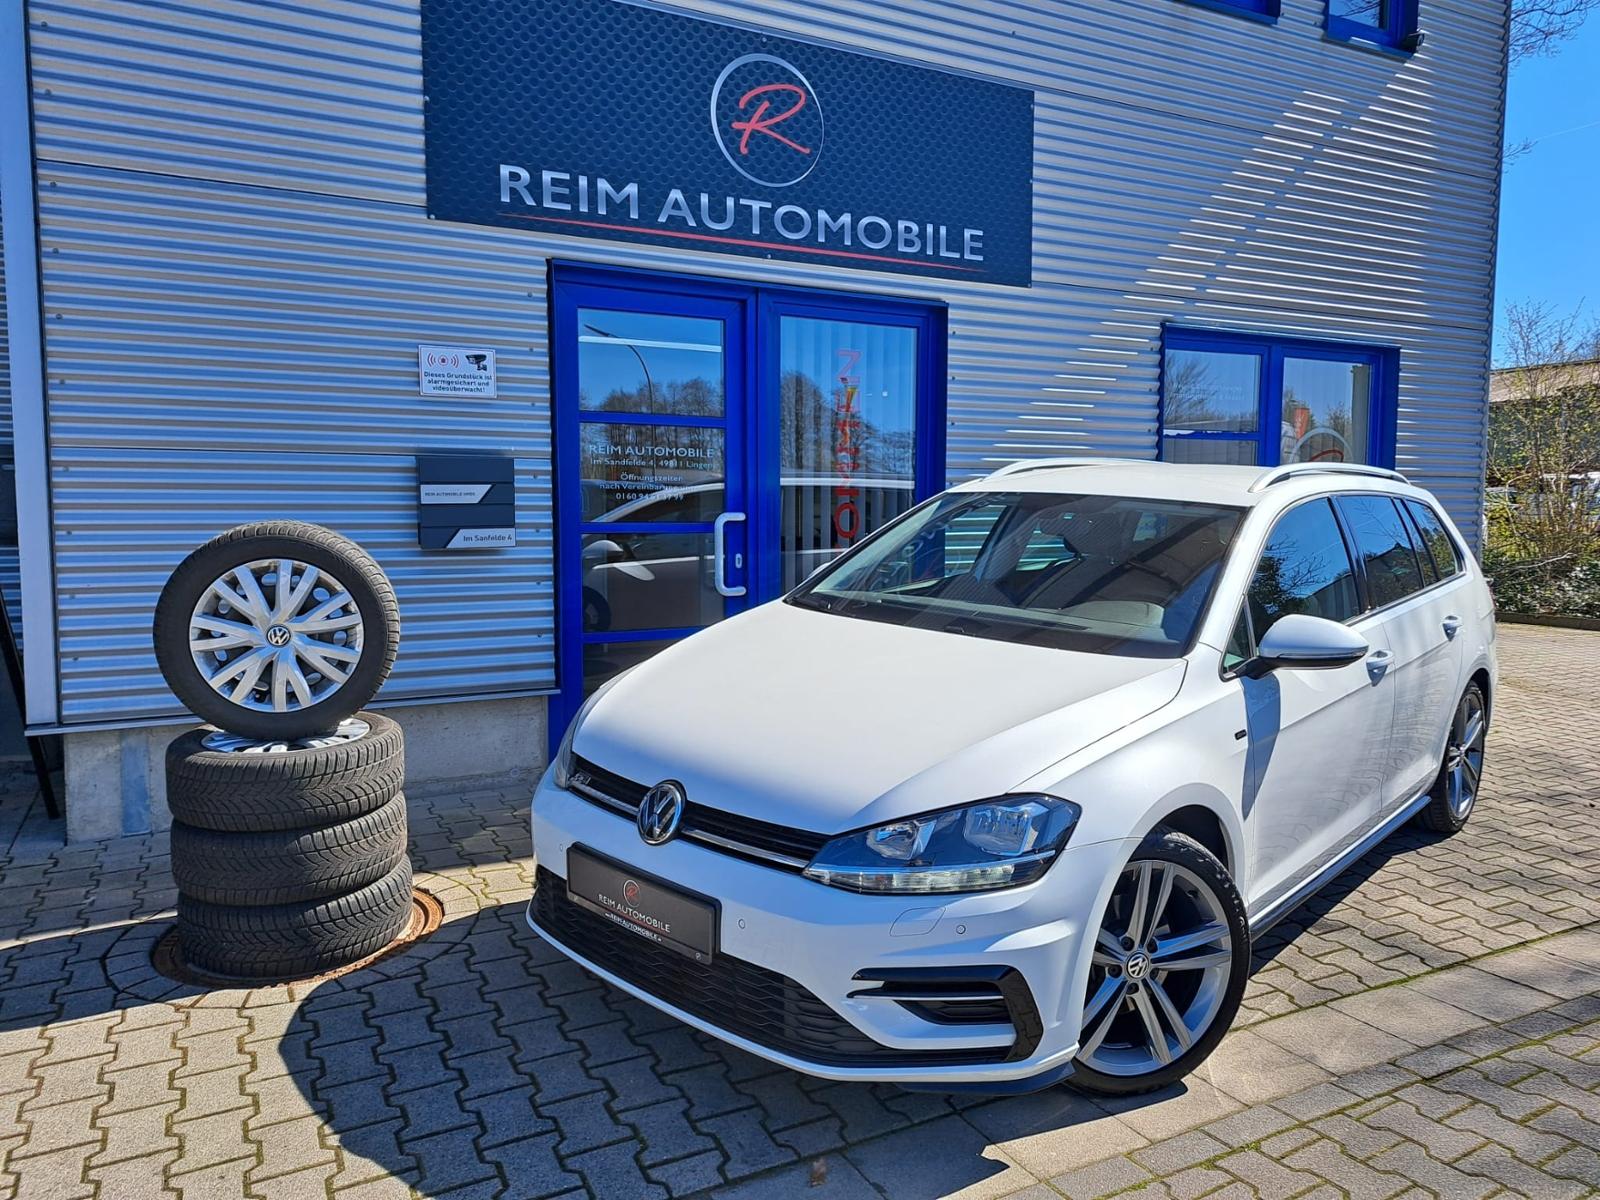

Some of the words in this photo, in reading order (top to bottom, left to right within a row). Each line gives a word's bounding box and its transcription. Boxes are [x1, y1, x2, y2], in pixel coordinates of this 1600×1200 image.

[500, 164, 639, 219] REIM
[658, 188, 984, 261] AUTOMOBILE
[424, 371, 446, 379] Dieses
[447, 372, 483, 380] Grundstück
[427, 378, 476, 386] alarmgesichert
[589, 445, 622, 455] REIM
[625, 446, 715, 458] AUTOMOBILE
[604, 458, 646, 466] Sandfelde
[620, 472, 683, 483] Öffnungszeiten
[598, 894, 616, 908] REIM
[616, 903, 671, 933] AUTOMOBILE
